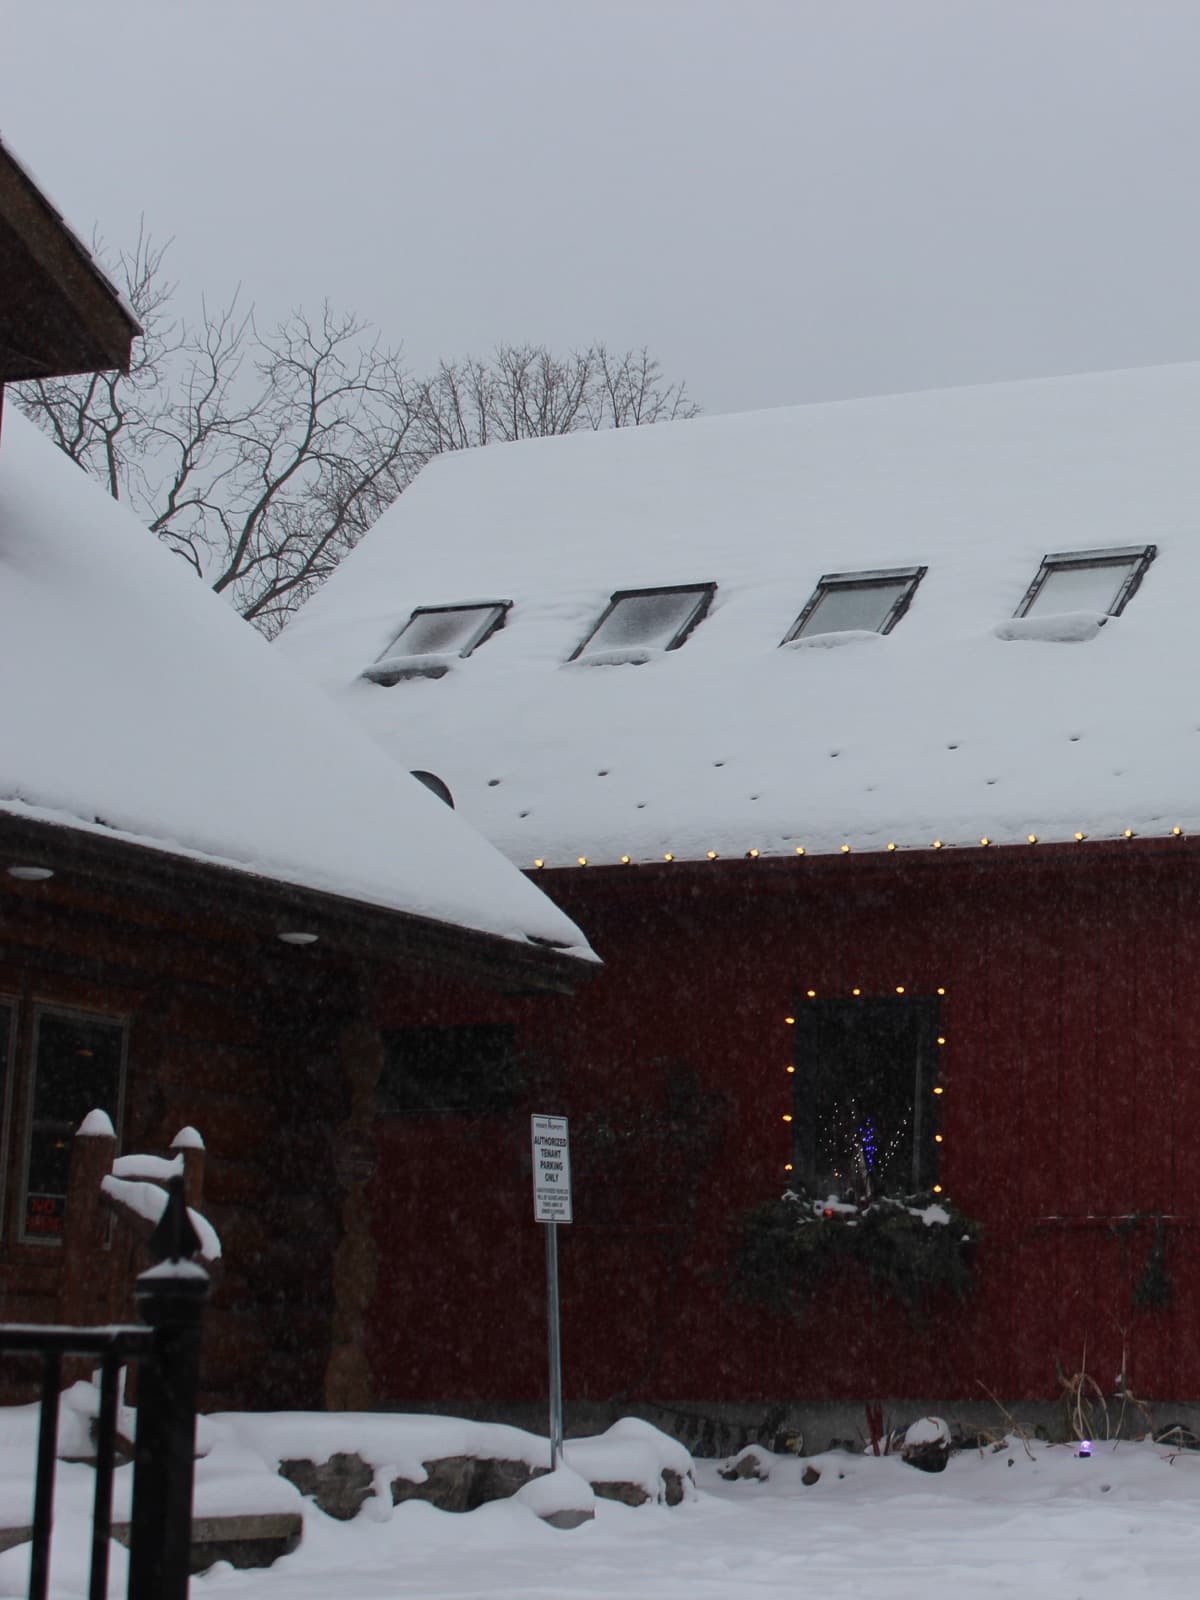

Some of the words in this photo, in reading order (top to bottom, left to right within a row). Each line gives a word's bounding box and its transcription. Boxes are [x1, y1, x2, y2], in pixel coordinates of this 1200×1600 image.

[534, 1136, 567, 1147] AUTHORIZED
[540, 1148, 561, 1158] TENANT
[540, 1160, 563, 1171] PARKING
[544, 1173, 559, 1182] ONLY
